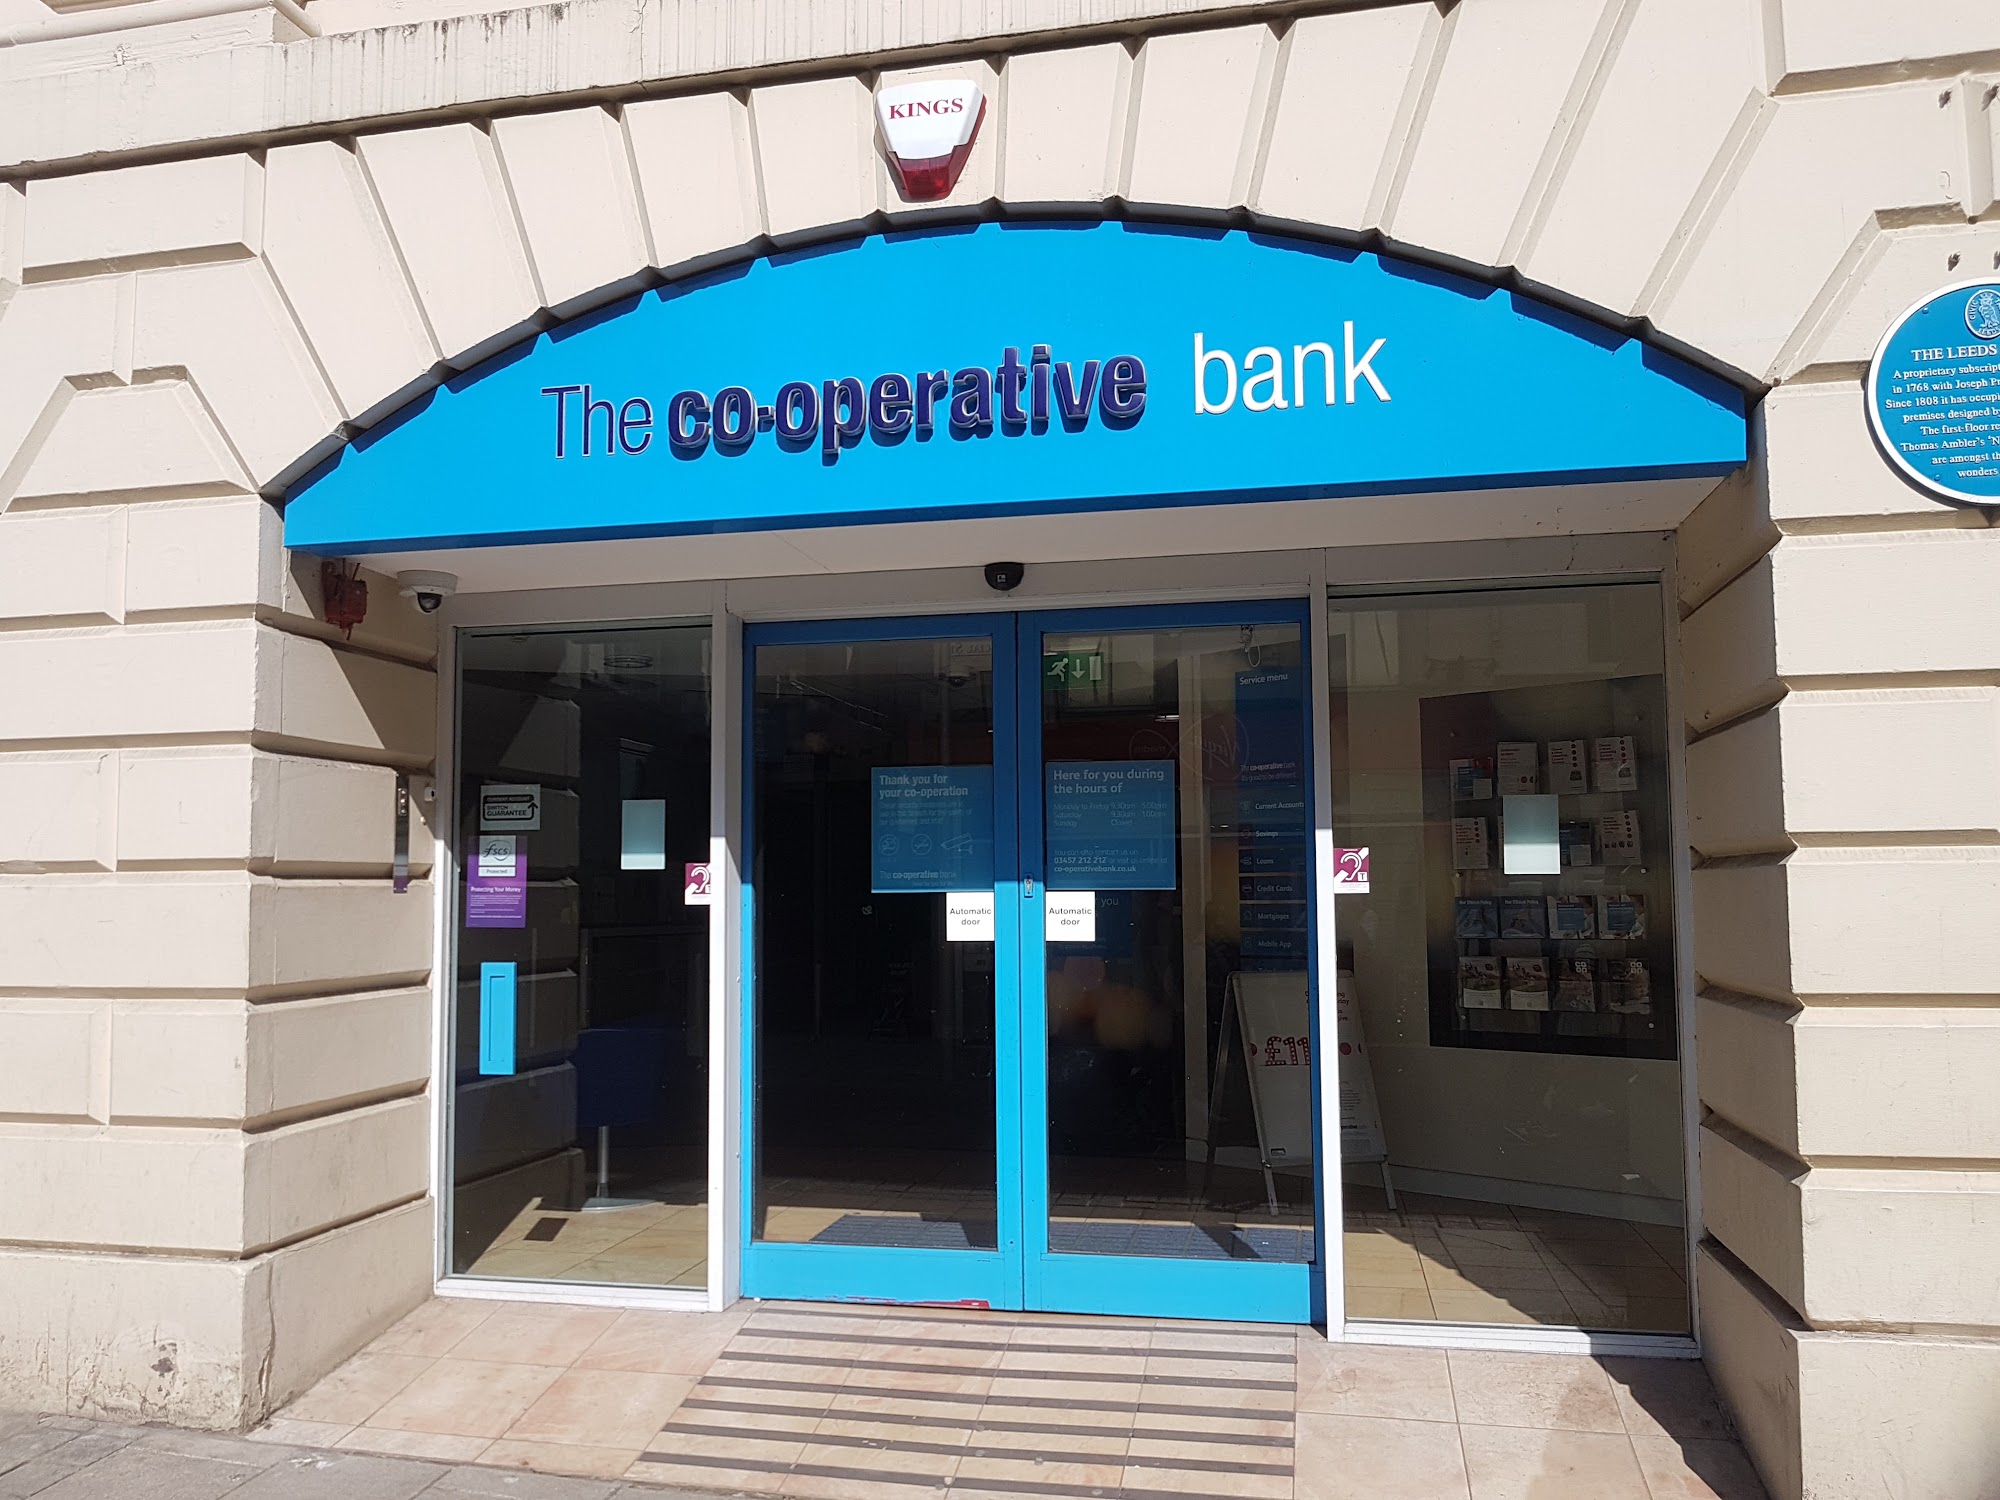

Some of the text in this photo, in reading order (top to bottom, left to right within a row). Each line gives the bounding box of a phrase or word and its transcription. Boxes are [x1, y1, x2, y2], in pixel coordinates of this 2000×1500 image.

[889, 97, 964, 119] KINGS
[1911, 344, 1998, 361] THE LEEDS
[1893, 370, 1902, 379] A
[1903, 366, 1956, 379] proprietary
[541, 320, 1391, 459] The co-operative bank
[1892, 385, 1902, 393] in
[1906, 383, 1929, 393] 1768
[1931, 381, 1952, 391] with
[1955, 378, 1988, 390] Joseph
[1885, 398, 1912, 409] Since
[1915, 396, 1939, 407] 1808
[1941, 395, 1948, 405] it
[1950, 395, 1967, 404] has
[1903, 411, 1945, 423] premises
[1947, 407, 1990, 420] designed
[1920, 425, 1940, 435] The
[1941, 422, 1988, 434] first-floor
[1900, 441, 1939, 452] Thomas
[1941, 436, 1985, 449] Ambler's
[1931, 456, 1948, 465] are
[1949, 452, 1989, 465] amongst
[1957, 466, 1998, 477] wonders
[1239, 673, 1288, 685] Service menu
[1250, 762, 1283, 772] co-operative
[879, 773, 948, 787] Thank you for
[1053, 769, 1164, 782] Here for you during
[879, 786, 969, 799] your co-operation
[1053, 782, 1123, 794] the hours of
[1255, 802, 1276, 810] Current
[1255, 830, 1278, 838] Savings
[1256, 857, 1274, 865] Loans
[892, 870, 938, 880] co-operative
[1053, 865, 1137, 873] co-operativebank.co.uk
[1100, 898, 1119, 908] you
[949, 907, 992, 915] Automatic
[1048, 907, 1092, 915] Automatic
[1257, 912, 1290, 920] Mortgages
[1258, 940, 1291, 949] Mobile App
[1264, 1036, 1311, 1066] £11
